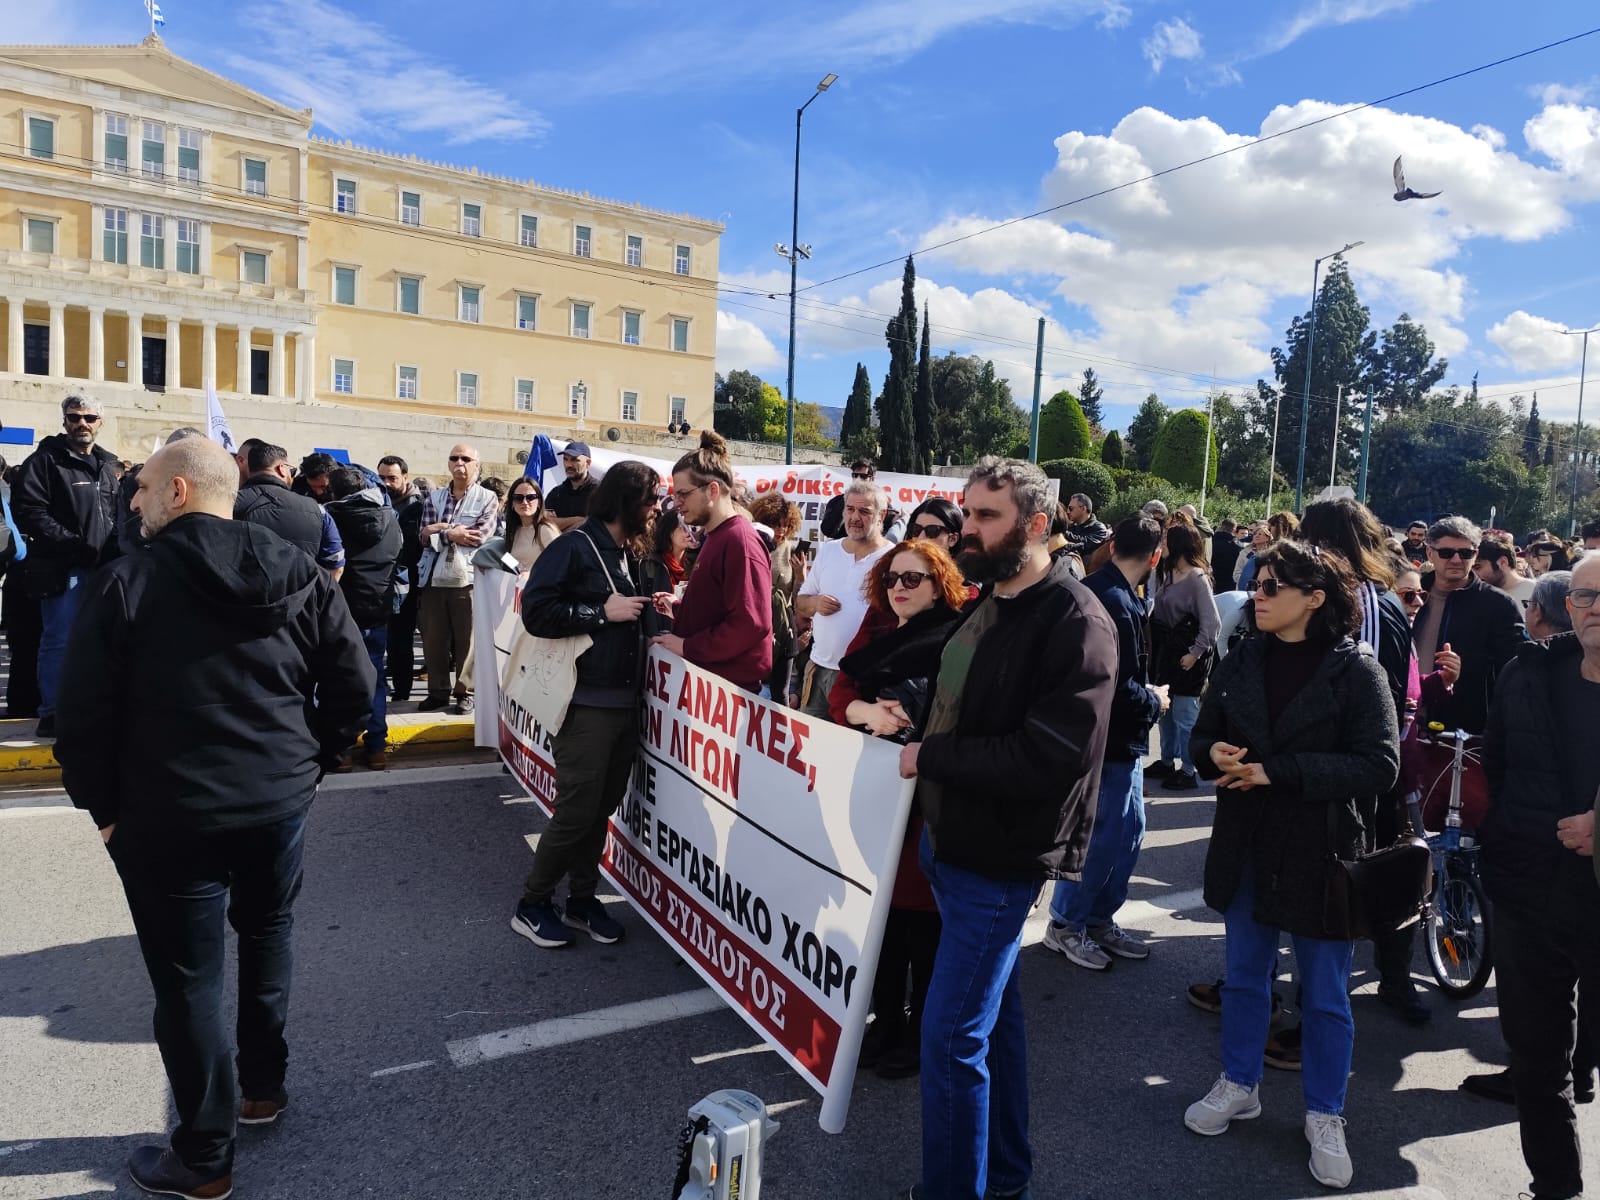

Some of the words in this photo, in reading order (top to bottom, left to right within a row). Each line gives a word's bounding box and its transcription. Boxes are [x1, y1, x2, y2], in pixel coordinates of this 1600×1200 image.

[756, 478, 779, 494] οι
[782, 470, 844, 496] δικές
[639, 700, 662, 749] ΩΝ
[670, 718, 741, 800] ΛΙΓΩΝ
[647, 656, 671, 703] ΑΣ
[677, 671, 816, 792] ΑΝΑΓΚΕΣ,
[602, 832, 661, 912] ΥΣΙΚΟΣ
[667, 888, 786, 1030] ΣΥΛΛΟΓΟΣ
[657, 819, 772, 945] ΕΡΓΑΣΙΑΚΟ
